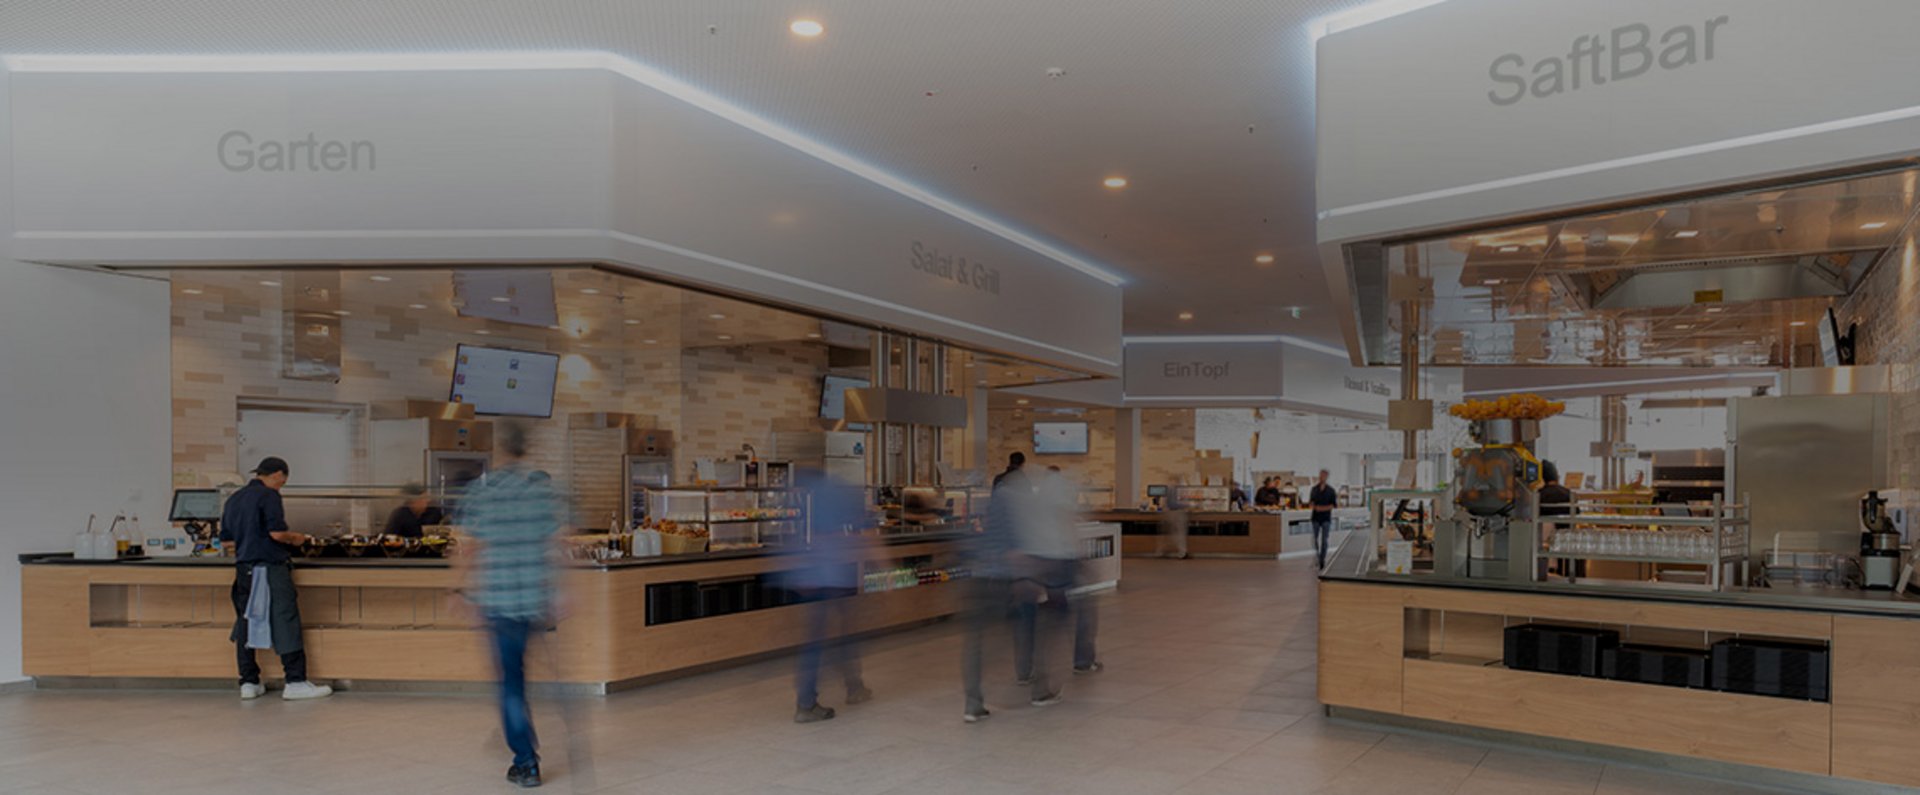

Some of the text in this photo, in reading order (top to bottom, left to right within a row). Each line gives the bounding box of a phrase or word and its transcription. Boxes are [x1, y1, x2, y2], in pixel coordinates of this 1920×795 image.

[1488, 16, 1729, 105] SaftBar
[217, 131, 376, 171] Garten
[910, 239, 1000, 296] Salat & Grill
[1163, 361, 1230, 380] EinTopf
